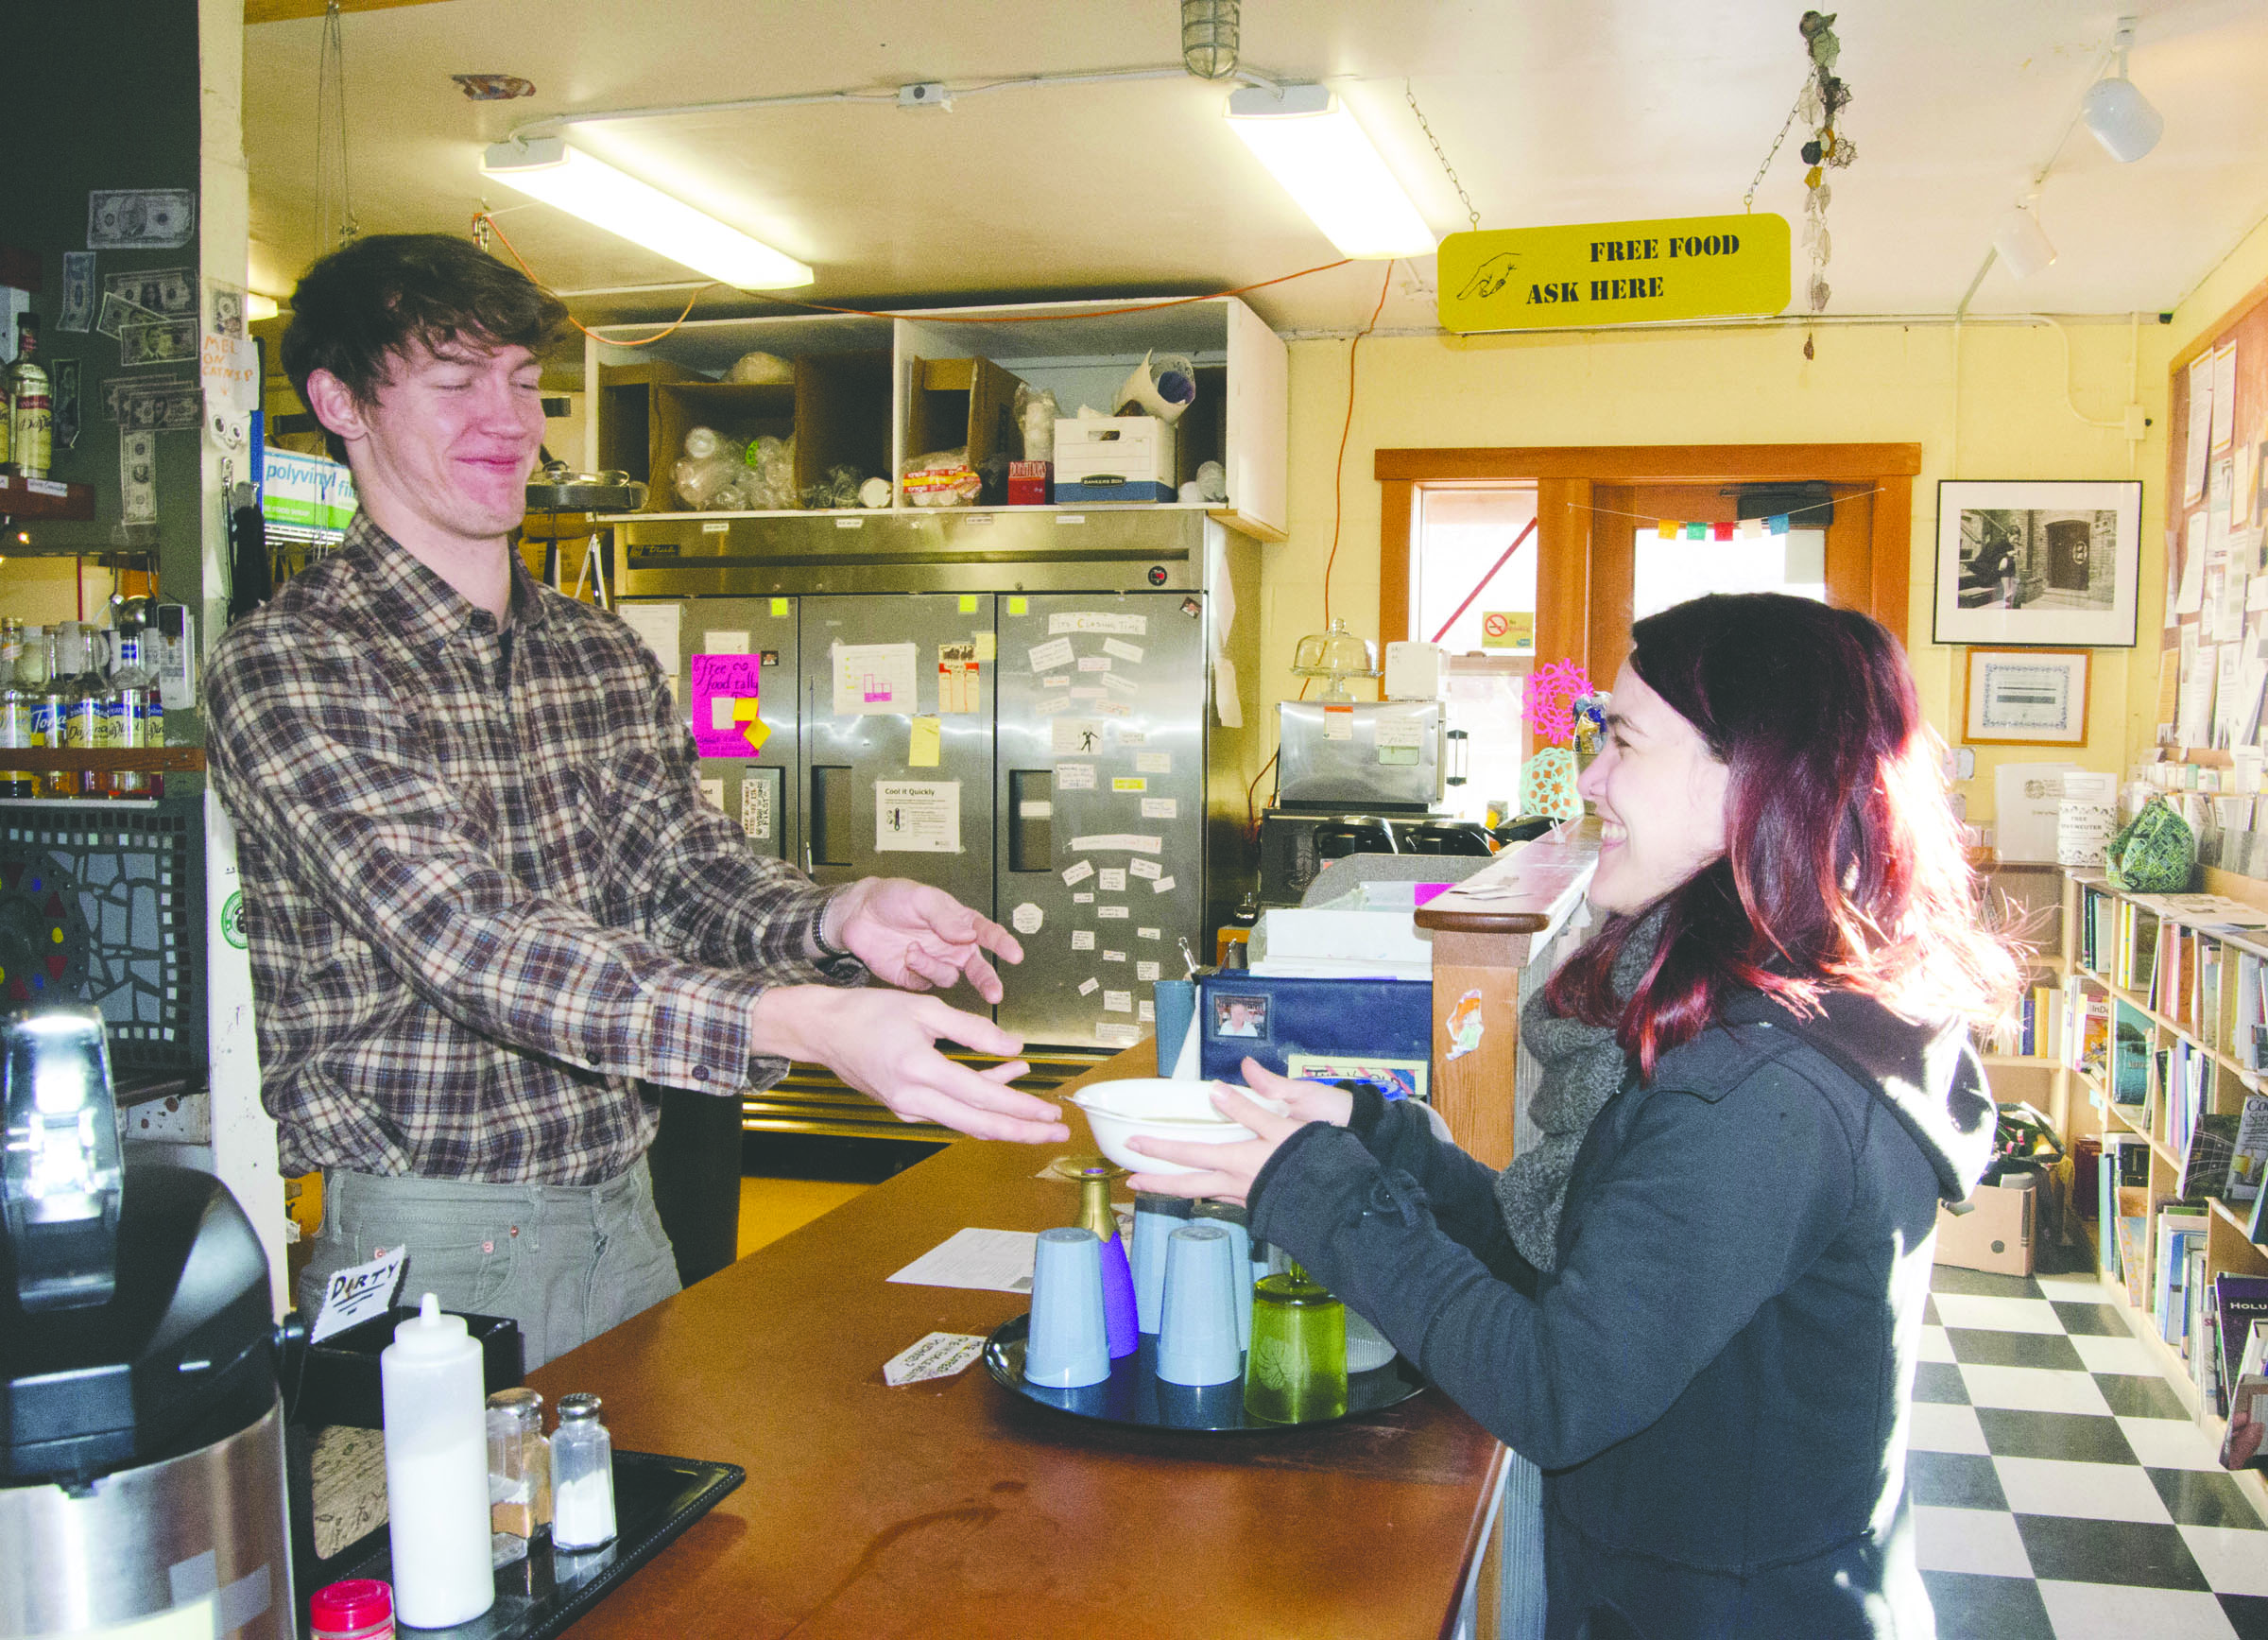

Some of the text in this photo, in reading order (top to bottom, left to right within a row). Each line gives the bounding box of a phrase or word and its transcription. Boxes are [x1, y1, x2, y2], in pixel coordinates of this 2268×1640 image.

[1589, 234, 1740, 263] FREE FOOD
[1526, 277, 1664, 304] ASK HERE
[203, 354, 226, 364] ON
[201, 366, 253, 382] CATNIP
[266, 463, 336, 491] polyvinyl
[909, 788, 936, 797] Quickly
[331, 1260, 399, 1301] DIRTY
[2230, 1302, 2268, 1310] HOLU
